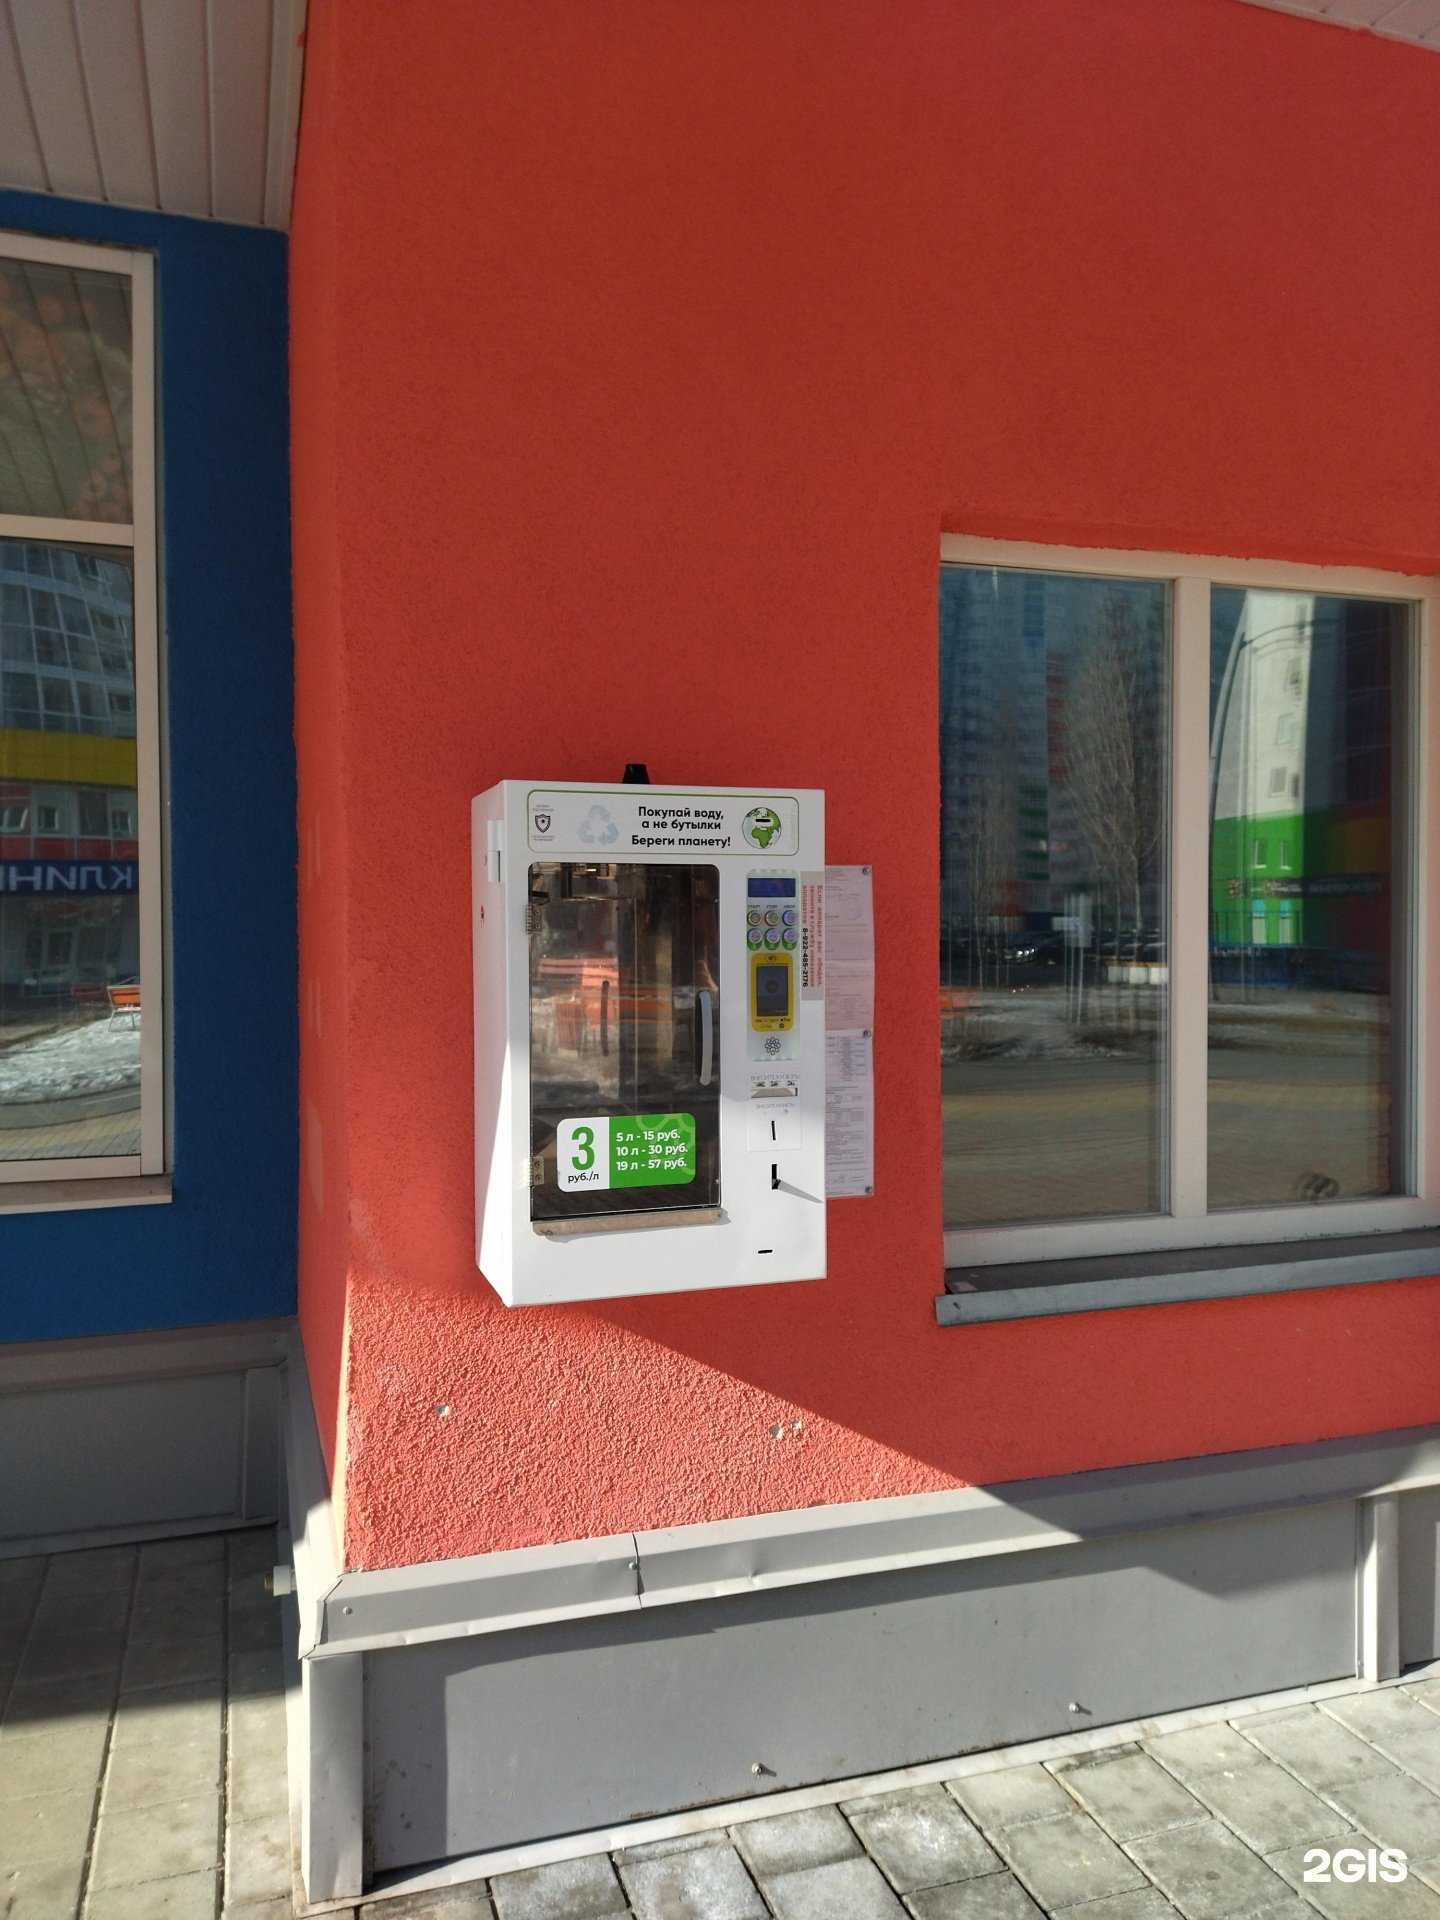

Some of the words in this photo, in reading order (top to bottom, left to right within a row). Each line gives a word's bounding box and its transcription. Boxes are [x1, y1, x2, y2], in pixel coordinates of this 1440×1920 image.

[638, 806, 691, 819] Покупай
[694, 810, 724, 820] воду,
[641, 821, 650, 829] а
[653, 821, 668, 829] не
[671, 819, 721, 831] бутылки
[631, 835, 675, 847] Береги
[678, 836, 731, 848] планету!
[616, 1132, 623, 1142] 5
[626, 1132, 634, 1141] л
[643, 1130, 655, 1140] 15
[657, 1129, 681, 1140] руб.
[571, 1126, 595, 1171] 3
[616, 1146, 629, 1156] 10
[631, 1146, 639, 1156] л
[648, 1145, 662, 1155] 30
[665, 1142, 688, 1156] руб.
[616, 1161, 629, 1171] 19
[630, 1160, 639, 1170] л
[648, 1159, 661, 1169] 57
[664, 1158, 687, 1169] руб.
[567, 1171, 599, 1183] руб./л
